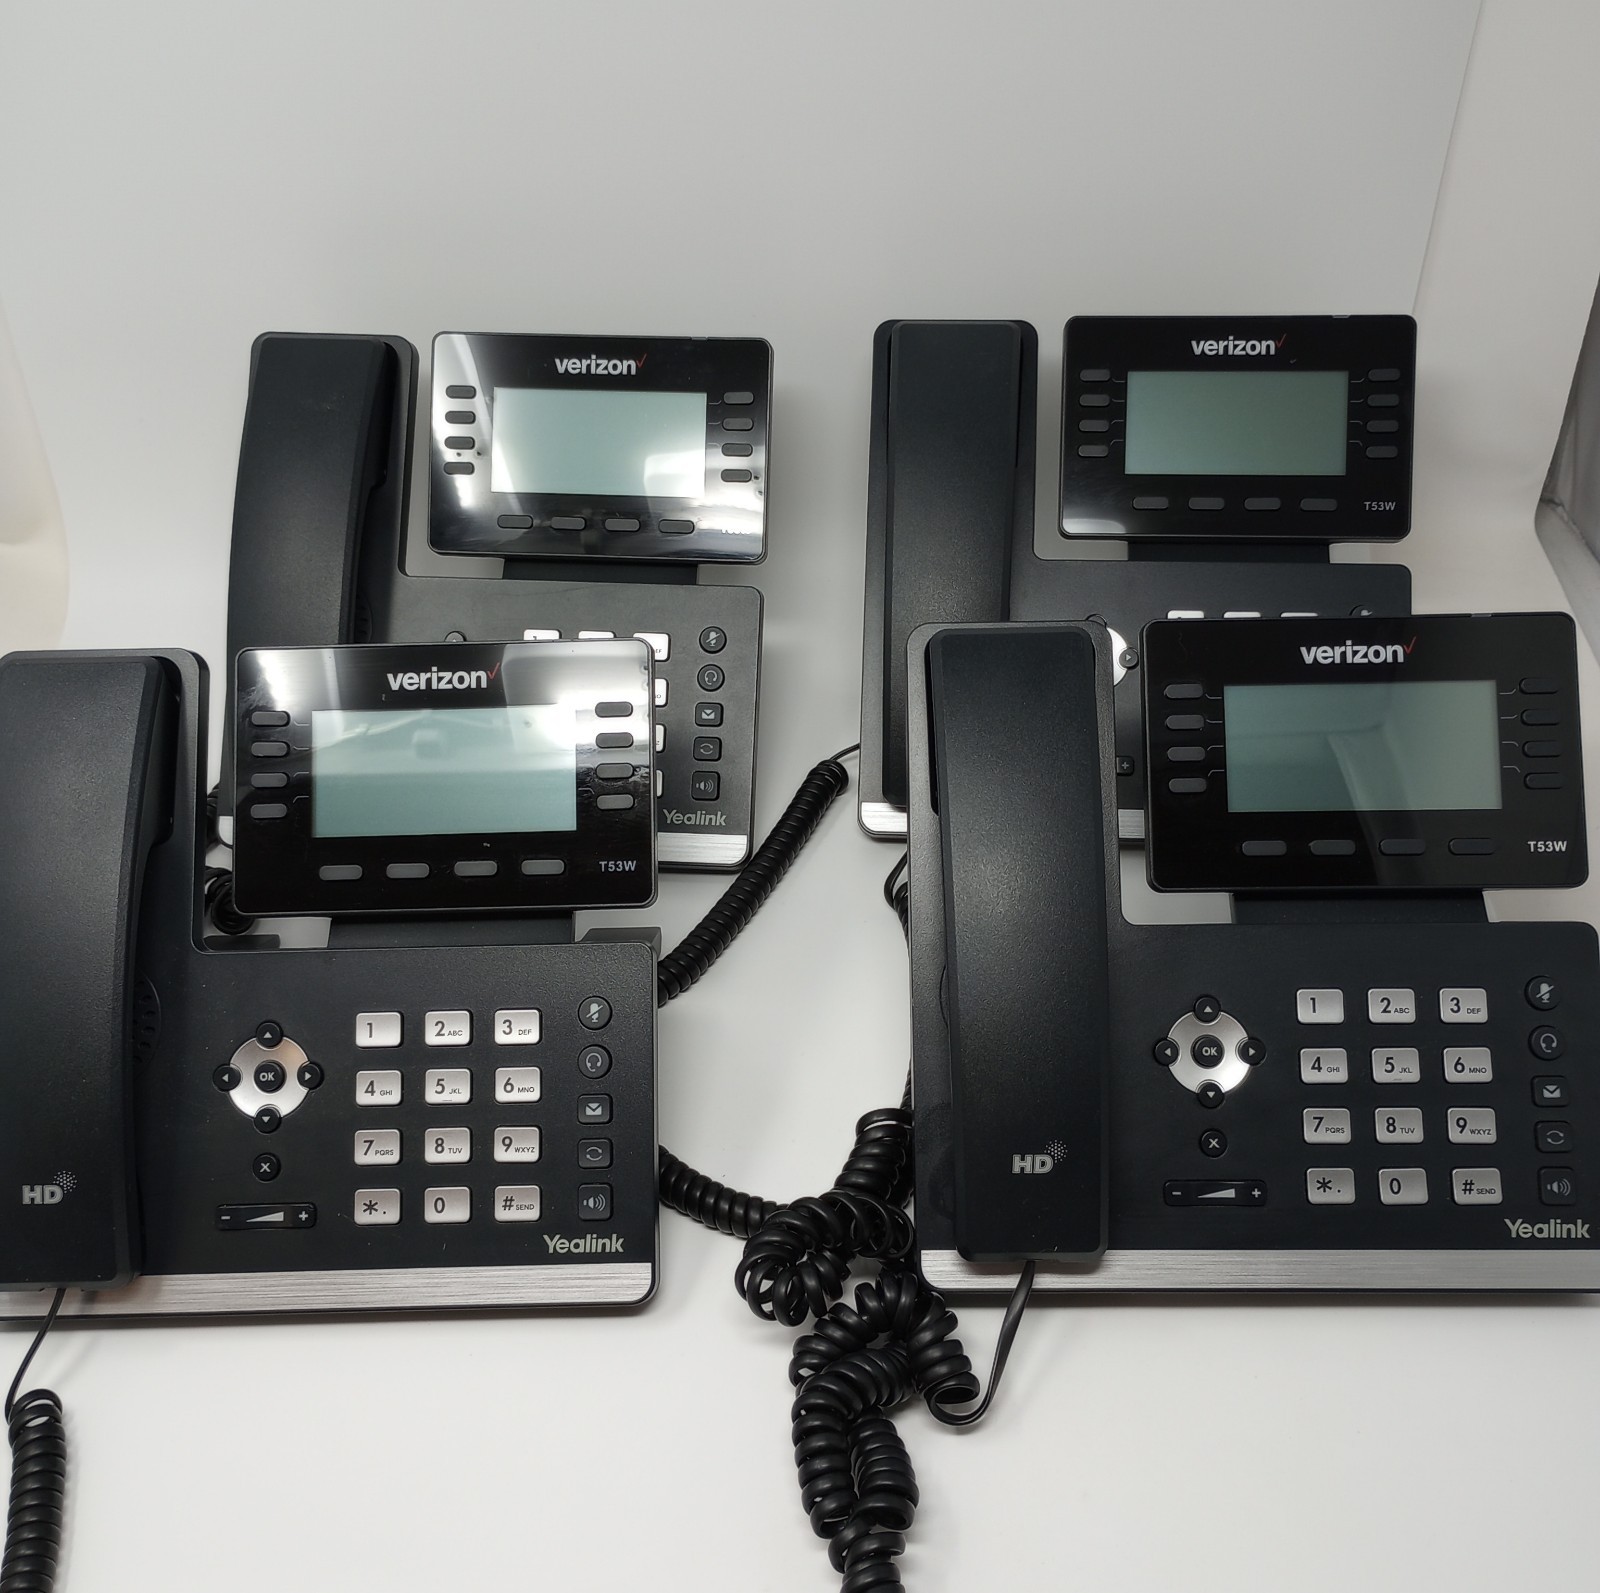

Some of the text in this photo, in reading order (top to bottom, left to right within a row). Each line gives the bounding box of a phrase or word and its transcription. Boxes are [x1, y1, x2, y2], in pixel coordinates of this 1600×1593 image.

[1190, 335, 1275, 356] verizon
[555, 354, 636, 376] verizon
[1363, 501, 1396, 511] T53W
[1299, 639, 1404, 664] verizon
[387, 666, 487, 691] verizon
[663, 809, 726, 826] Yealink
[1527, 841, 1567, 852] T53W
[599, 860, 637, 872] T53W
[1310, 997, 1317, 1013] 1
[1380, 997, 1392, 1014] 2
[1450, 997, 1461, 1014] 3
[366, 1022, 373, 1038] 1
[434, 1020, 446, 1037] 2
[502, 1019, 513, 1036] 3
[1202, 1046, 1218, 1056] OK
[1310, 1056, 1323, 1073] 4
[1384, 1056, 1395, 1074] 5
[1453, 1056, 1465, 1074] 6
[259, 1072, 275, 1082] OK
[503, 1077, 535, 1094] 6 MNO
[364, 1080, 376, 1096] 4
[434, 1078, 446, 1095] 5
[1312, 1116, 1324, 1133] 7
[1385, 1116, 1397, 1133] 8
[1455, 1116, 1467, 1134] 9
[363, 1140, 375, 1156] 7
[434, 1137, 445, 1154] 8
[501, 1136, 513, 1153] 9
[1011, 1154, 1054, 1174] HD
[22, 1184, 64, 1205] HD
[1389, 1178, 1401, 1195] 0
[433, 1197, 446, 1214] 0
[1503, 1218, 1591, 1239] Yealink
[542, 1233, 624, 1254] Yealink
